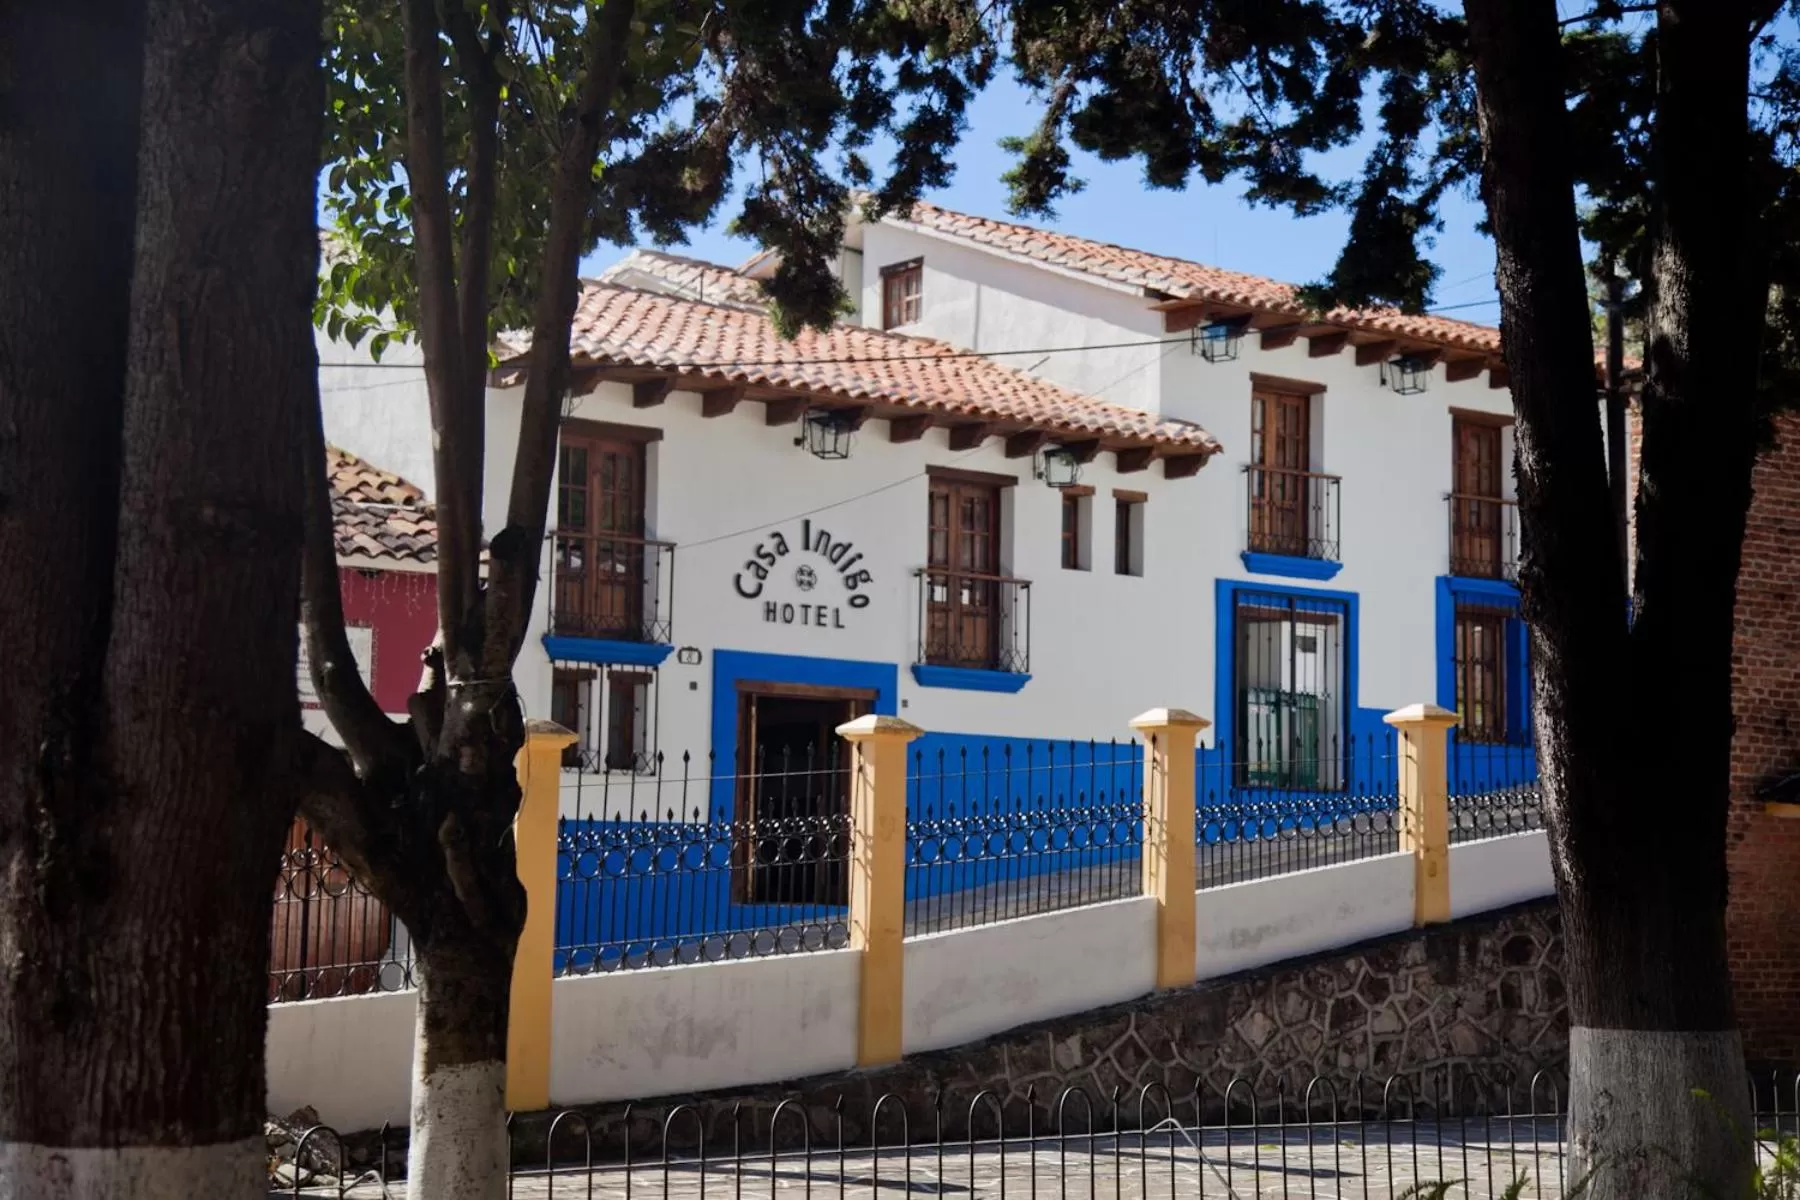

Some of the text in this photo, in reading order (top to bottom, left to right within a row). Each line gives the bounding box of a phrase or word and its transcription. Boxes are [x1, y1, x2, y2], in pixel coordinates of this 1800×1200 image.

[734, 519, 873, 608] Casa Indigo
[764, 601, 845, 629] HOTEL
